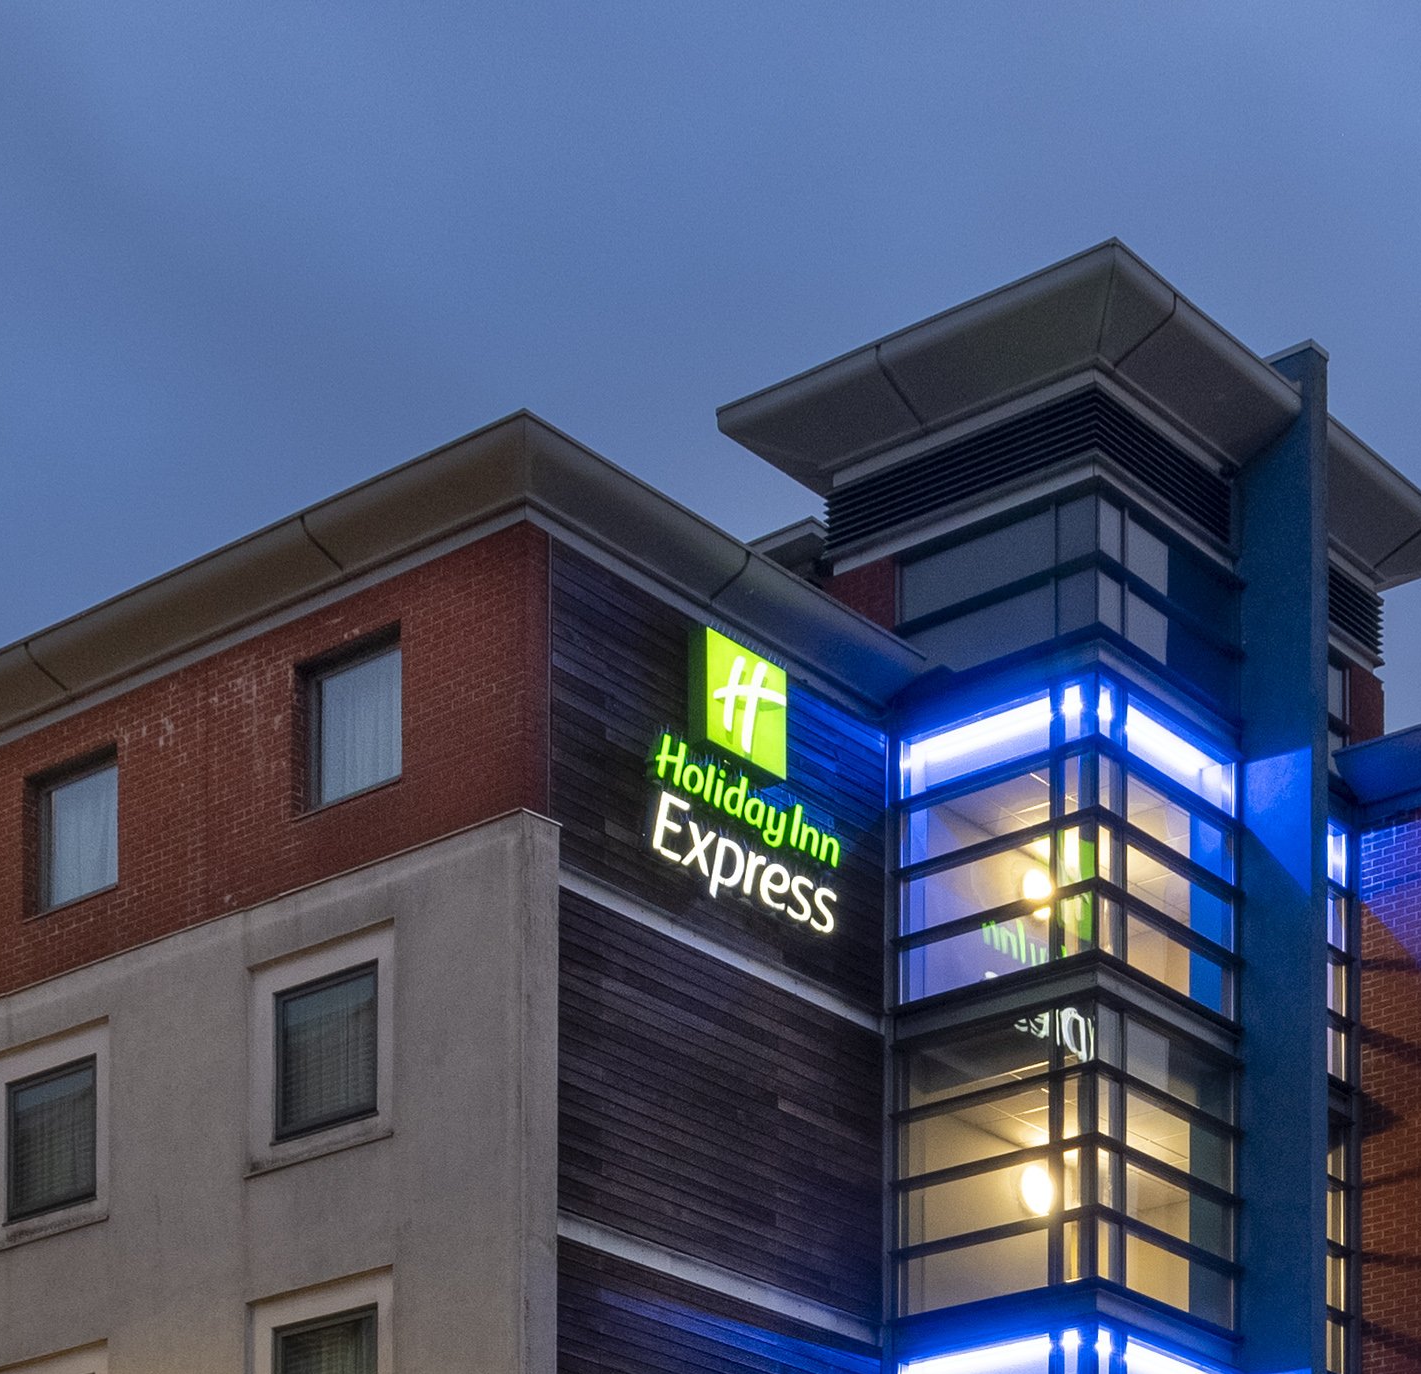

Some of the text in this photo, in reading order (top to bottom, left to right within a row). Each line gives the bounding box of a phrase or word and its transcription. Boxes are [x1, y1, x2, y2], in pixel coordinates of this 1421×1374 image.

[652, 790, 838, 934] Express
[655, 733, 840, 868] Holiday Inn
